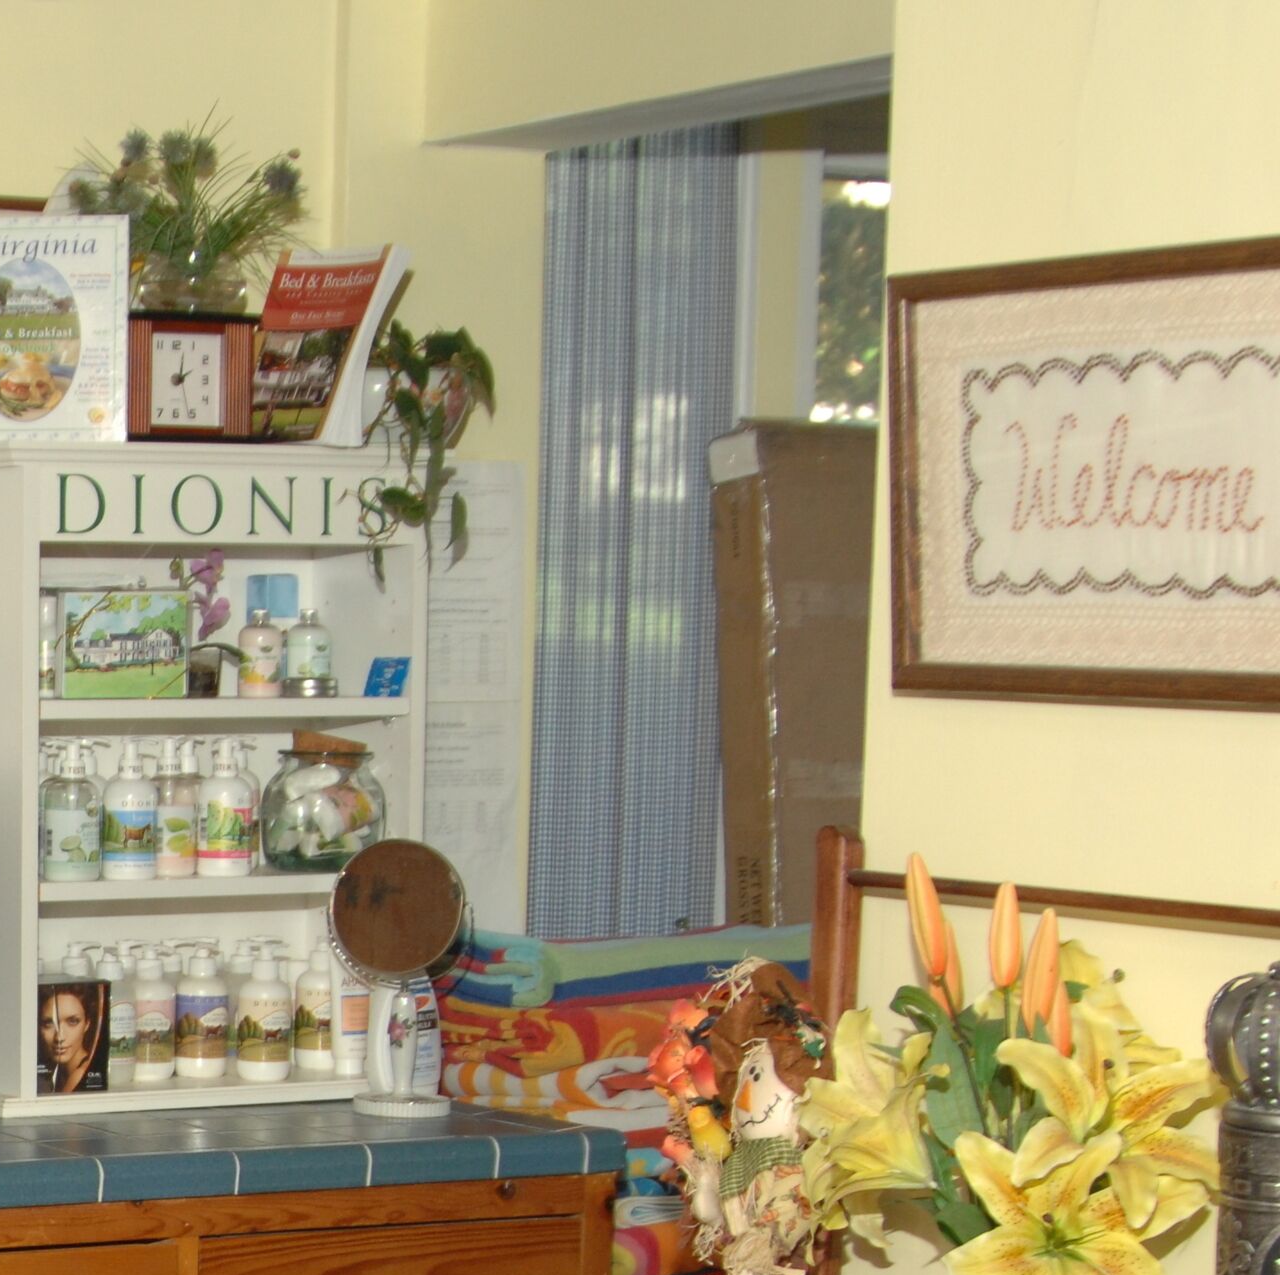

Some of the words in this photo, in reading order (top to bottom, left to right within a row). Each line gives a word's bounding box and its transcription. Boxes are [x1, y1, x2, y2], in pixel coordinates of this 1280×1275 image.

[278, 271, 306, 289] Bed
[306, 272, 322, 289] &
[322, 267, 377, 289] Breakfasts
[3, 327, 14, 338] &
[17, 326, 74, 338] Breakfast
[171, 340, 182, 350] 12
[201, 354, 209, 365] 2
[201, 375, 209, 385] 3
[201, 395, 209, 405] 4
[156, 408, 164, 418] 7
[172, 408, 180, 418] 6
[188, 408, 197, 419] 5
[1004, 412, 1264, 533] Welcome
[56, 473, 387, 537] DIONIS
